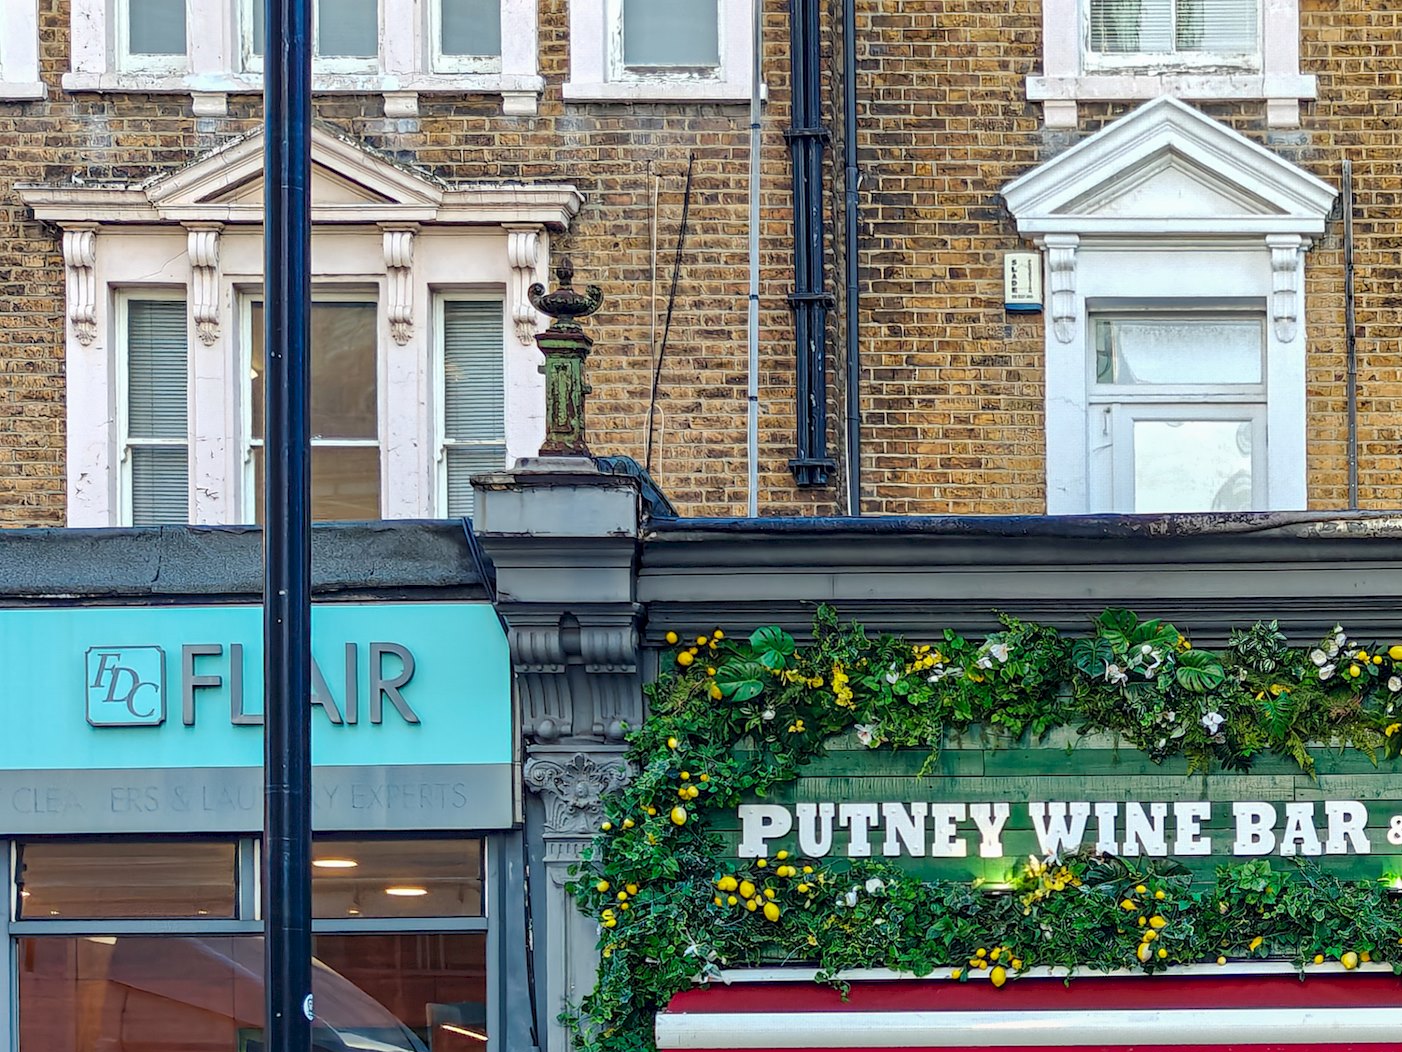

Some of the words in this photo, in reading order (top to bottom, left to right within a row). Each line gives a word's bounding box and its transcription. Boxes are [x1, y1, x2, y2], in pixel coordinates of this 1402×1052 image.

[90, 653, 159, 717] FDC
[12, 785, 160, 814] CLEAERS
[203, 784, 340, 811] LAUY
[351, 783, 468, 809] EXPERTS
[738, 802, 1010, 858] PUTNEY
[1029, 802, 1212, 857] WINE
[1232, 800, 1371, 856] BAR
